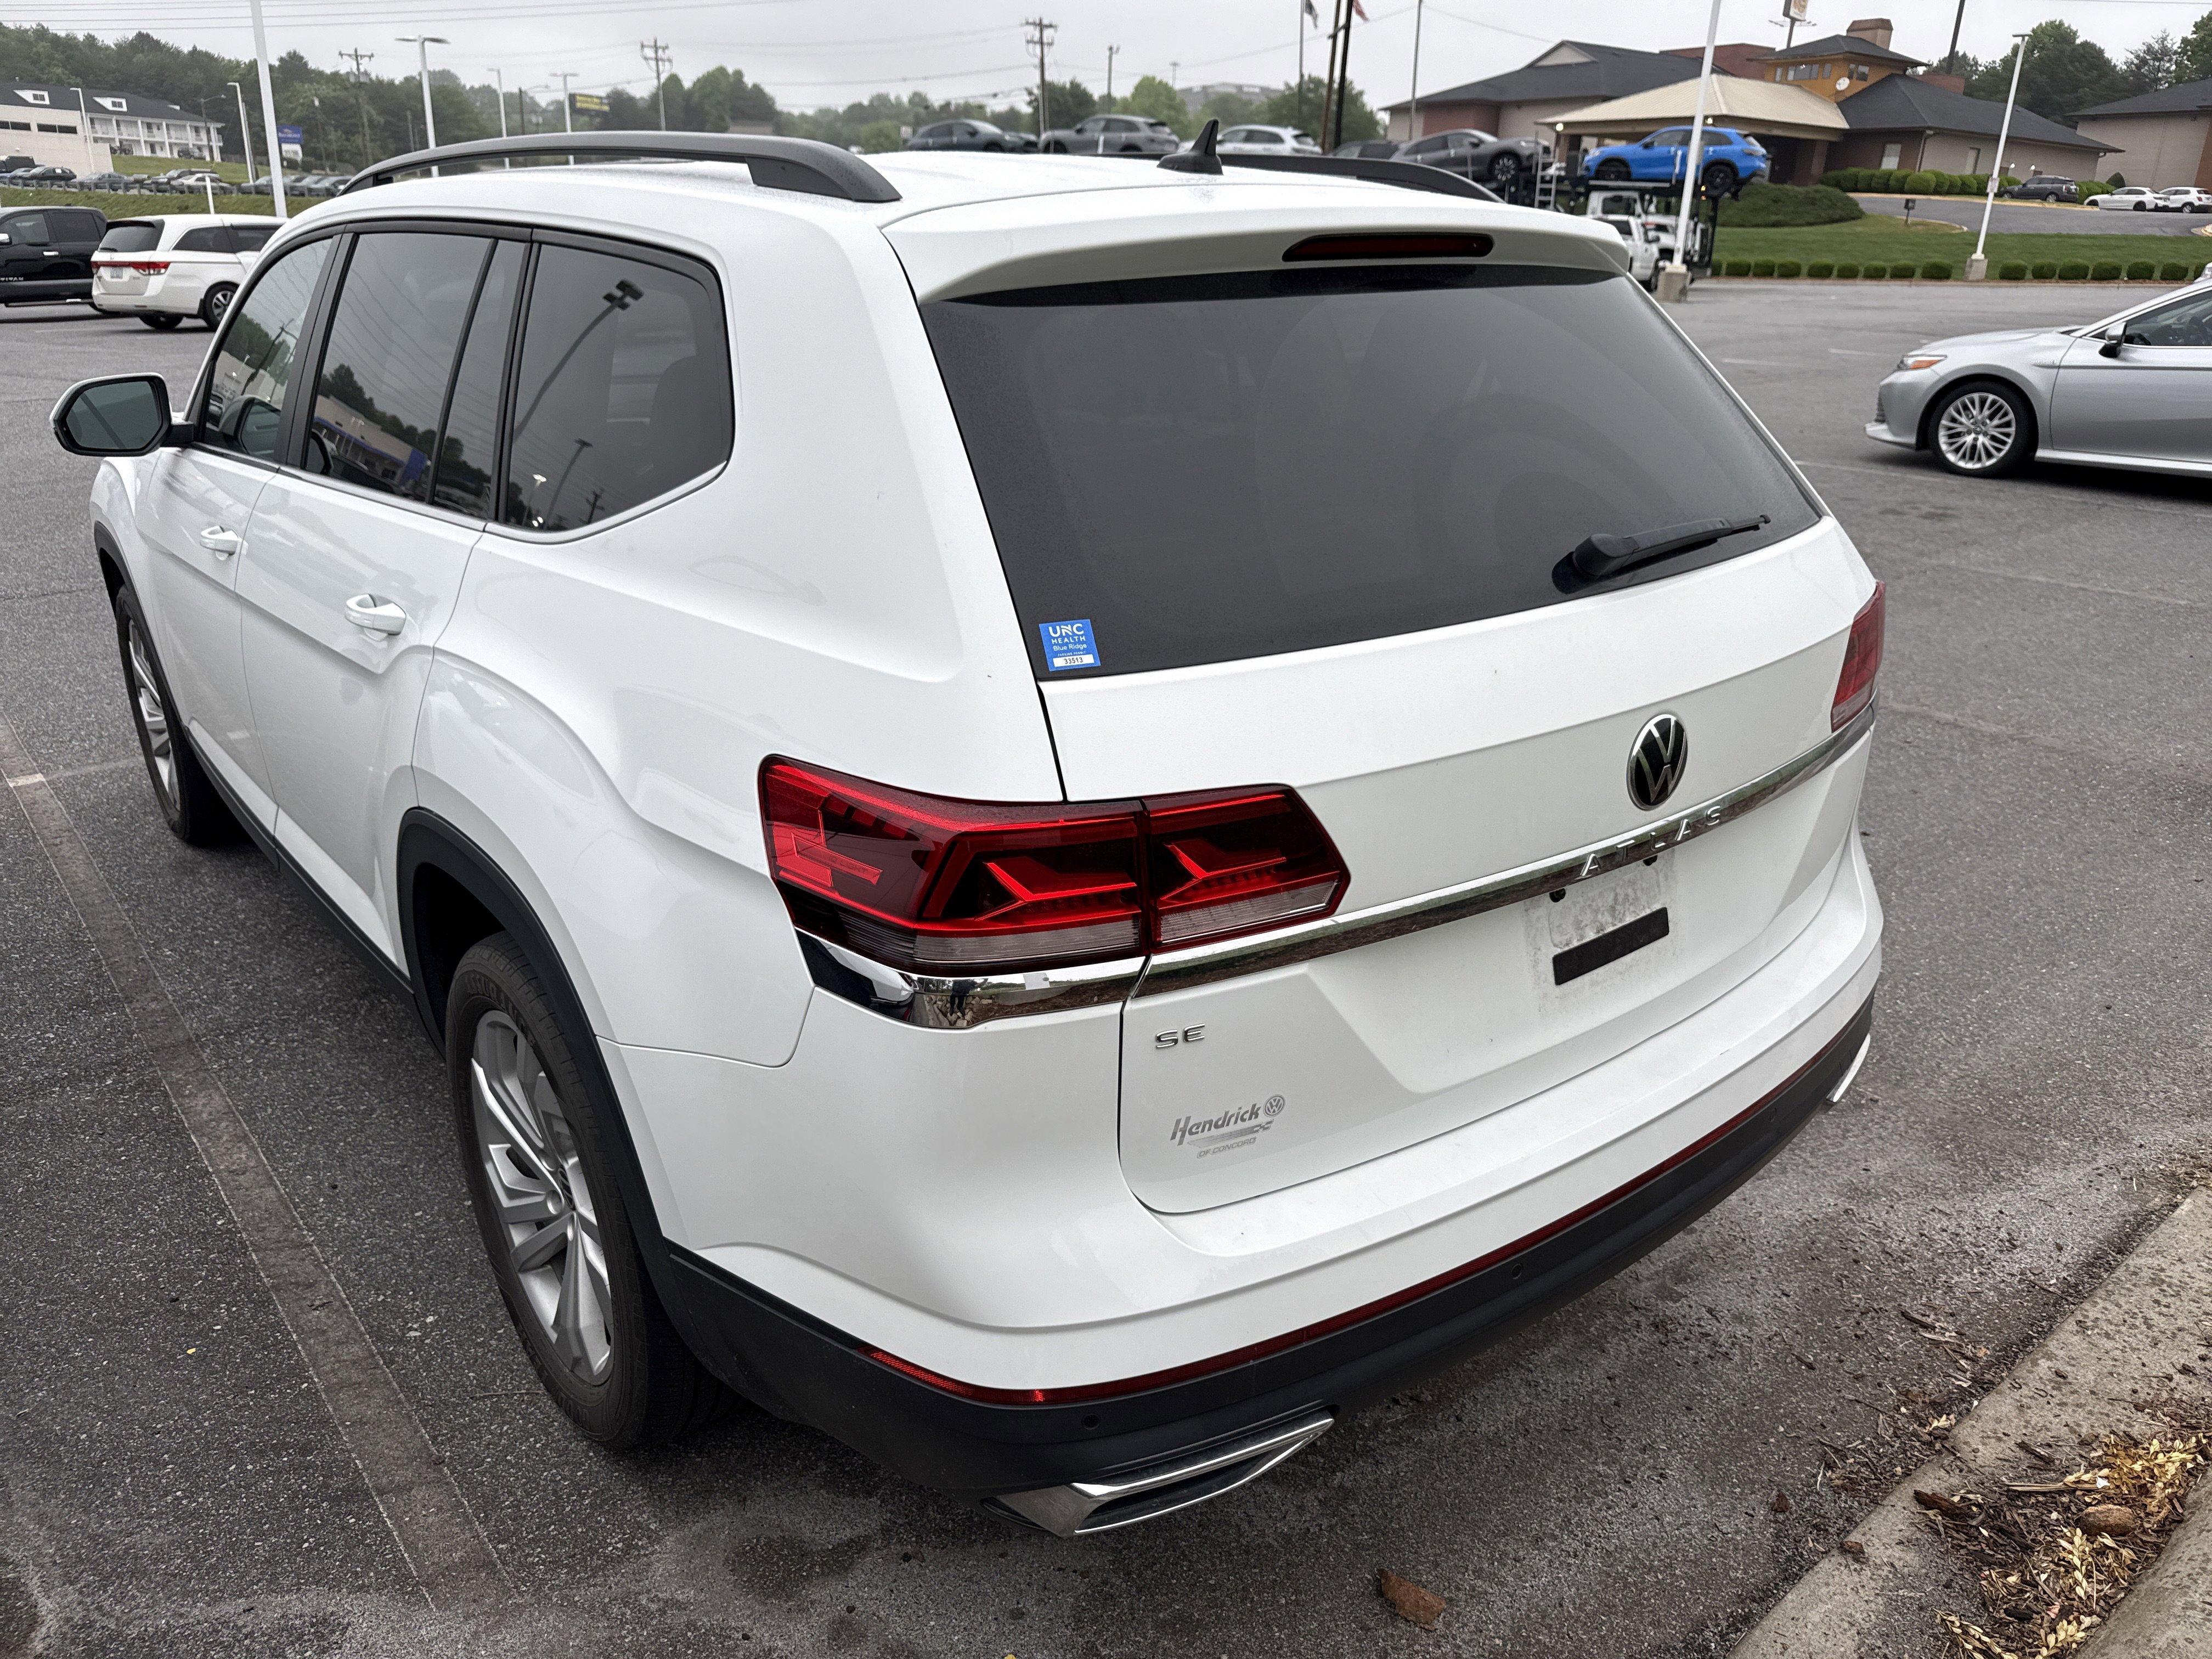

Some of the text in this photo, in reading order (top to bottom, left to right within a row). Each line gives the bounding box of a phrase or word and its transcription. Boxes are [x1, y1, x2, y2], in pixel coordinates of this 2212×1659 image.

[1048, 623, 1084, 637] UNC
[1051, 636, 1086, 644] HEALTH
[1580, 805, 1721, 877] ATLAS
[1155, 1023, 1205, 1050] SE
[1170, 1103, 1262, 1146] Hendrick
[1199, 1136, 1256, 1157] OF CONCORD
